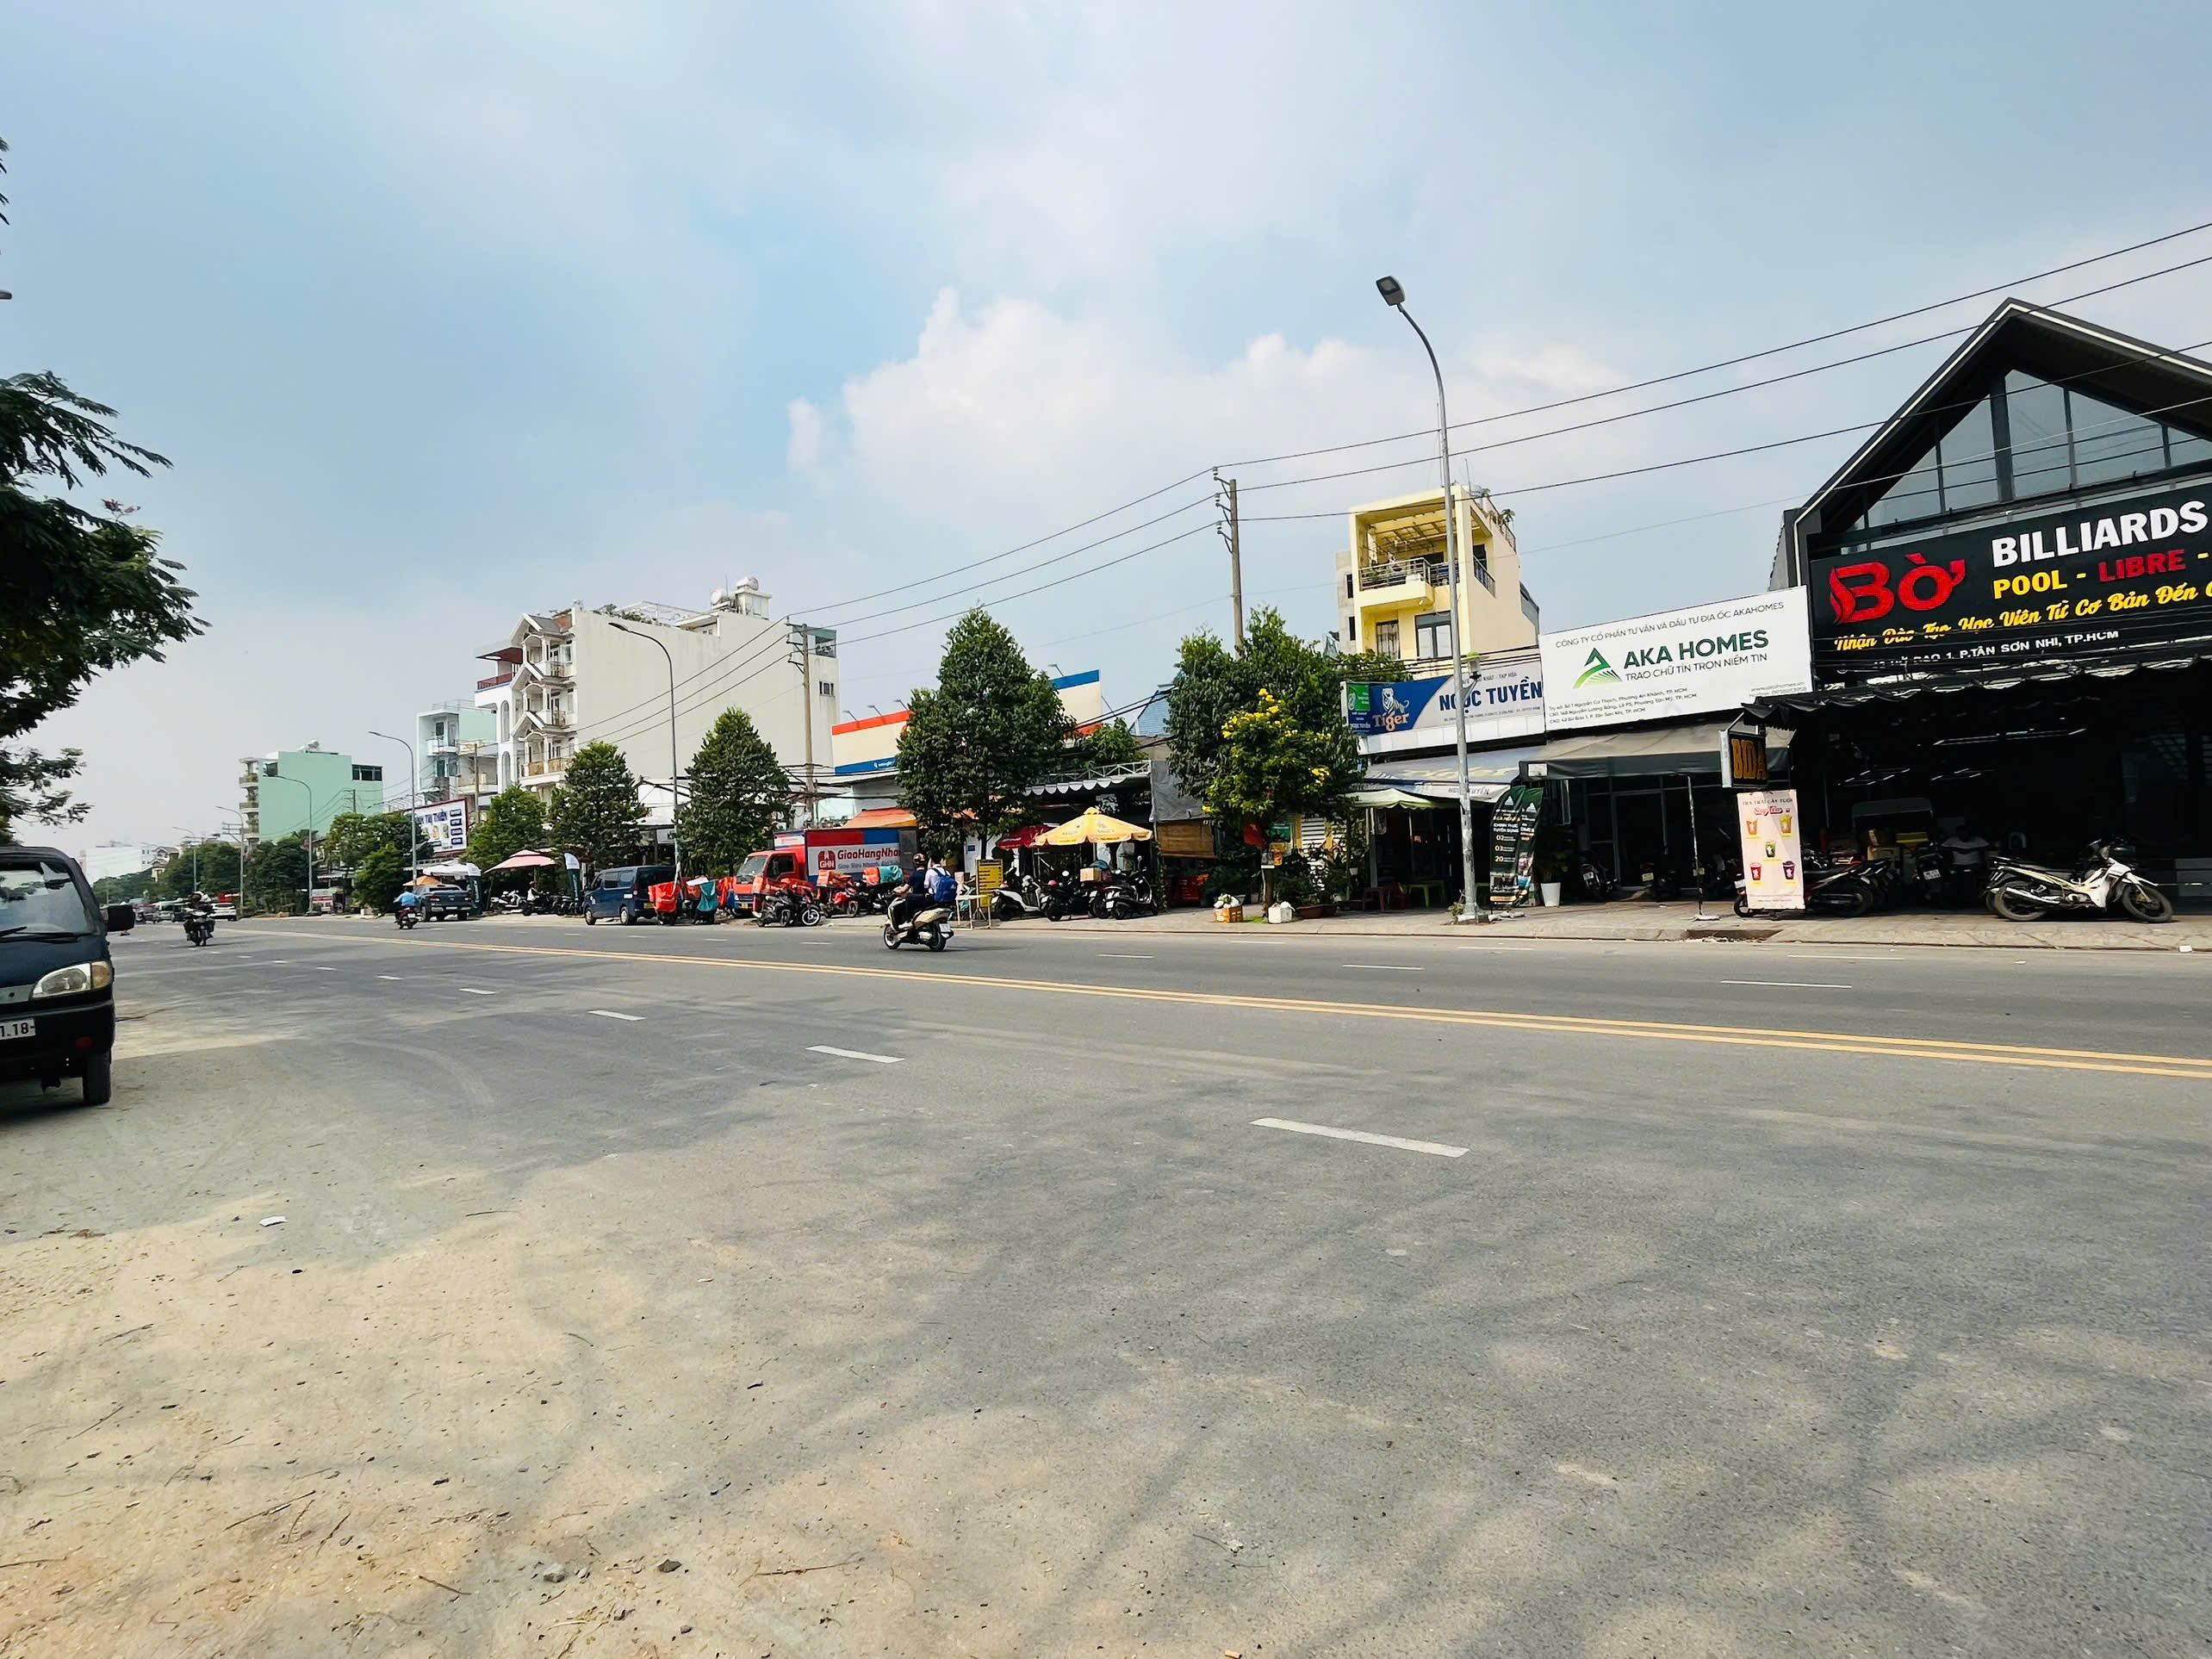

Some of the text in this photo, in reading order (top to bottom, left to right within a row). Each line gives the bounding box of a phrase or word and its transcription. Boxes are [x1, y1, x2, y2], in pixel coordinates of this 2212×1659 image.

[1991, 500, 2208, 568] BILLIARDS
[1992, 569, 2067, 600] POOL
[2098, 550, 2187, 583] LIBRE
[1732, 601, 1785, 617] AKAHOMES
[1999, 609, 2042, 627] Viên
[2075, 599, 2103, 617] Cơ
[2107, 591, 2151, 612] Bản
[2155, 581, 2199, 605] Đến
[1624, 629, 1769, 669] AKA HOMES
[2001, 640, 2030, 654] SƠN
[2064, 630, 2119, 645] TP.HCM
[1625, 669, 1651, 681] TRAO
[1749, 652, 1768, 662] TIN
[1486, 675, 1543, 705] TUYỀN
[1372, 711, 1410, 732] Tiger
